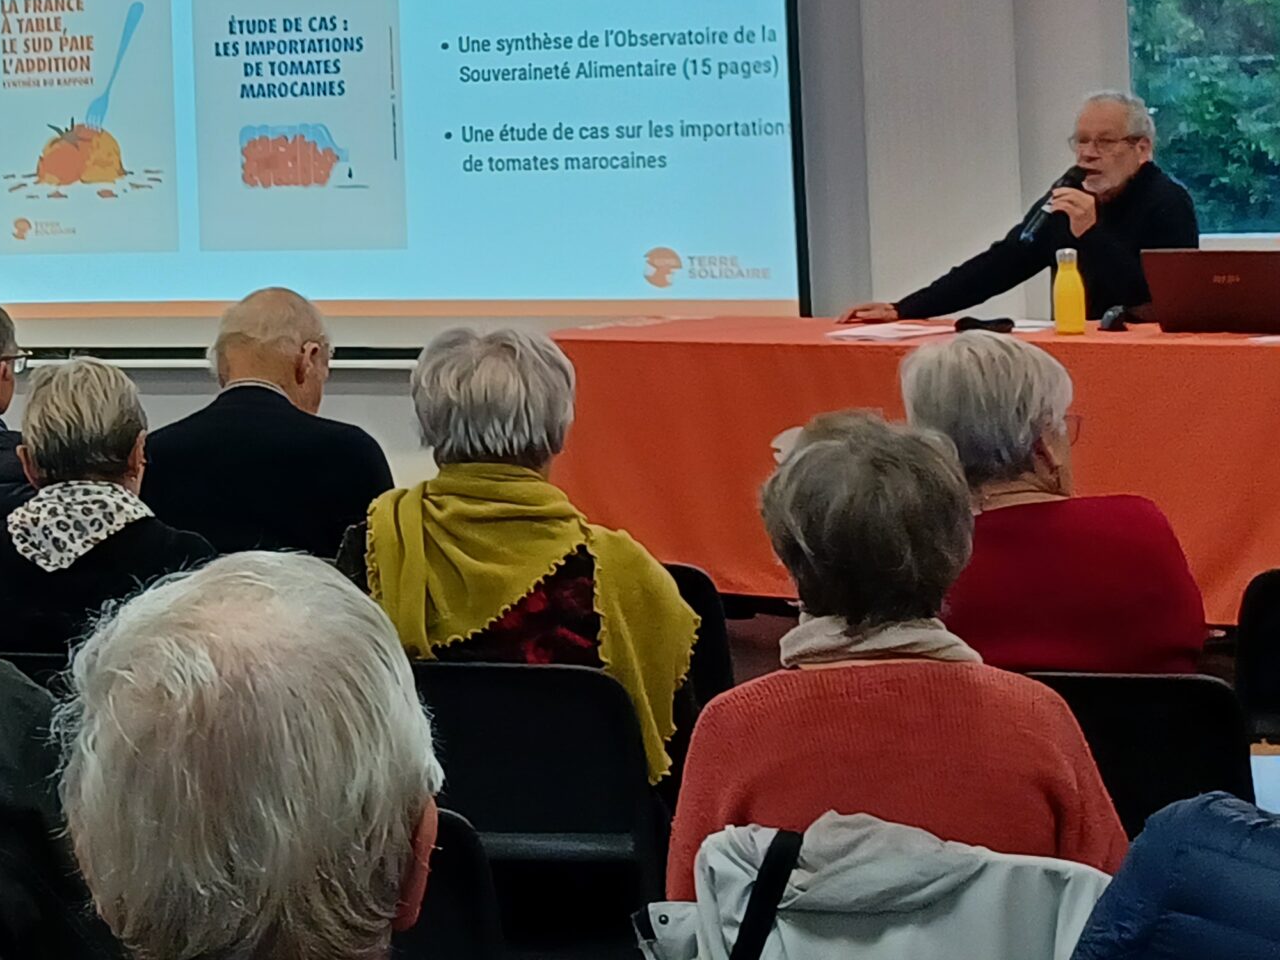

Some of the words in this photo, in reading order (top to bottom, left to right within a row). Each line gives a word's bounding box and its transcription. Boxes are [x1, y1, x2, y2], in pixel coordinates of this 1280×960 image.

[16, 16, 68, 36] TABLE,
[228, 16, 277, 35] ÉTUDE
[282, 17, 302, 32] DE
[308, 16, 337, 31] CAS
[2, 38, 18, 55] LE
[23, 36, 54, 53] SUD
[59, 35, 94, 52] PAIE
[214, 41, 240, 57] LES
[245, 37, 364, 56] IMPORTATIONS
[458, 36, 491, 53] Une
[495, 30, 573, 55] synthèse
[577, 30, 600, 48] de
[604, 25, 729, 48] l'Observatoire
[733, 26, 756, 43] de
[761, 25, 777, 43] la
[2, 54, 91, 75] L'ADDITION
[243, 61, 263, 77] DE
[269, 58, 341, 76] TOMATES
[459, 61, 571, 82] Souveraineté
[575, 57, 677, 80] Alimentaire
[682, 57, 713, 80] (15
[718, 54, 780, 79] pages)
[240, 79, 346, 99] MAROCAINES
[461, 125, 494, 142] Une
[499, 123, 548, 142] étude
[552, 122, 575, 141] de
[579, 124, 610, 140] cas
[615, 123, 643, 139] sur
[648, 120, 674, 138] les
[462, 154, 483, 172] de
[488, 153, 559, 171] tomates
[564, 150, 667, 170] marocaines
[687, 255, 739, 267] TERRE
[688, 267, 772, 280] SOLIDAIRE
